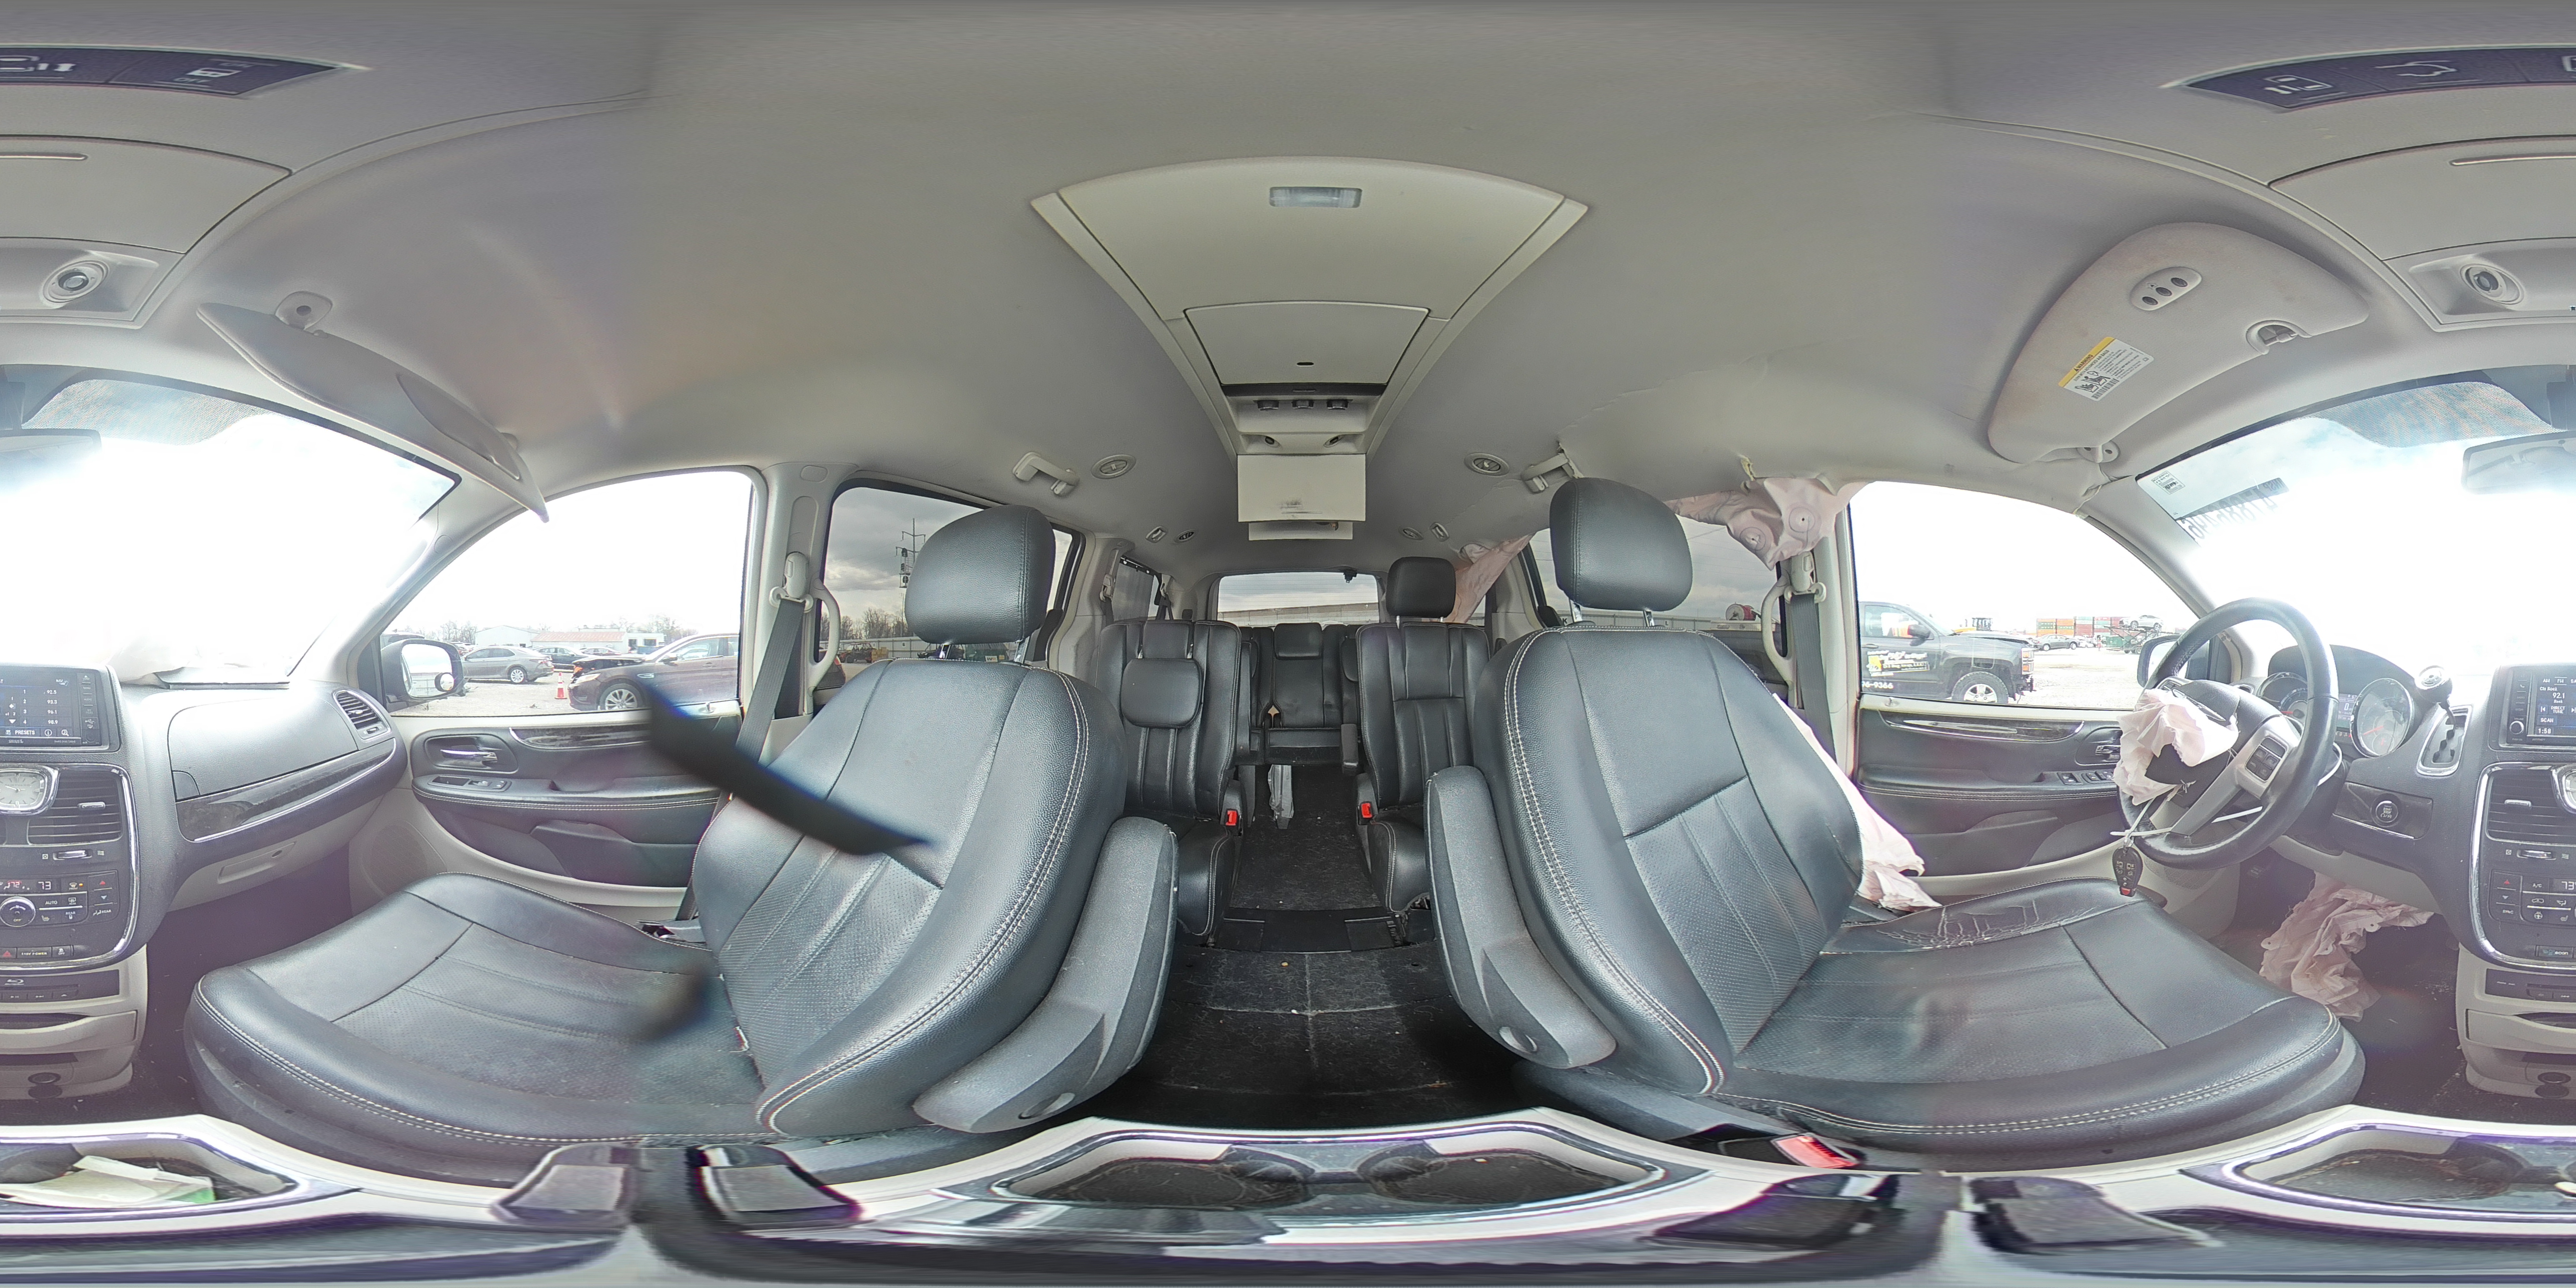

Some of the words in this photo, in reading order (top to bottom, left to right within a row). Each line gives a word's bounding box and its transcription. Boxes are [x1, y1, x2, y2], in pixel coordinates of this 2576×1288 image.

[2076, 354, 2093, 368] WARNING
[38, 881, 51, 890] 73
[2561, 881, 2575, 890] 73
